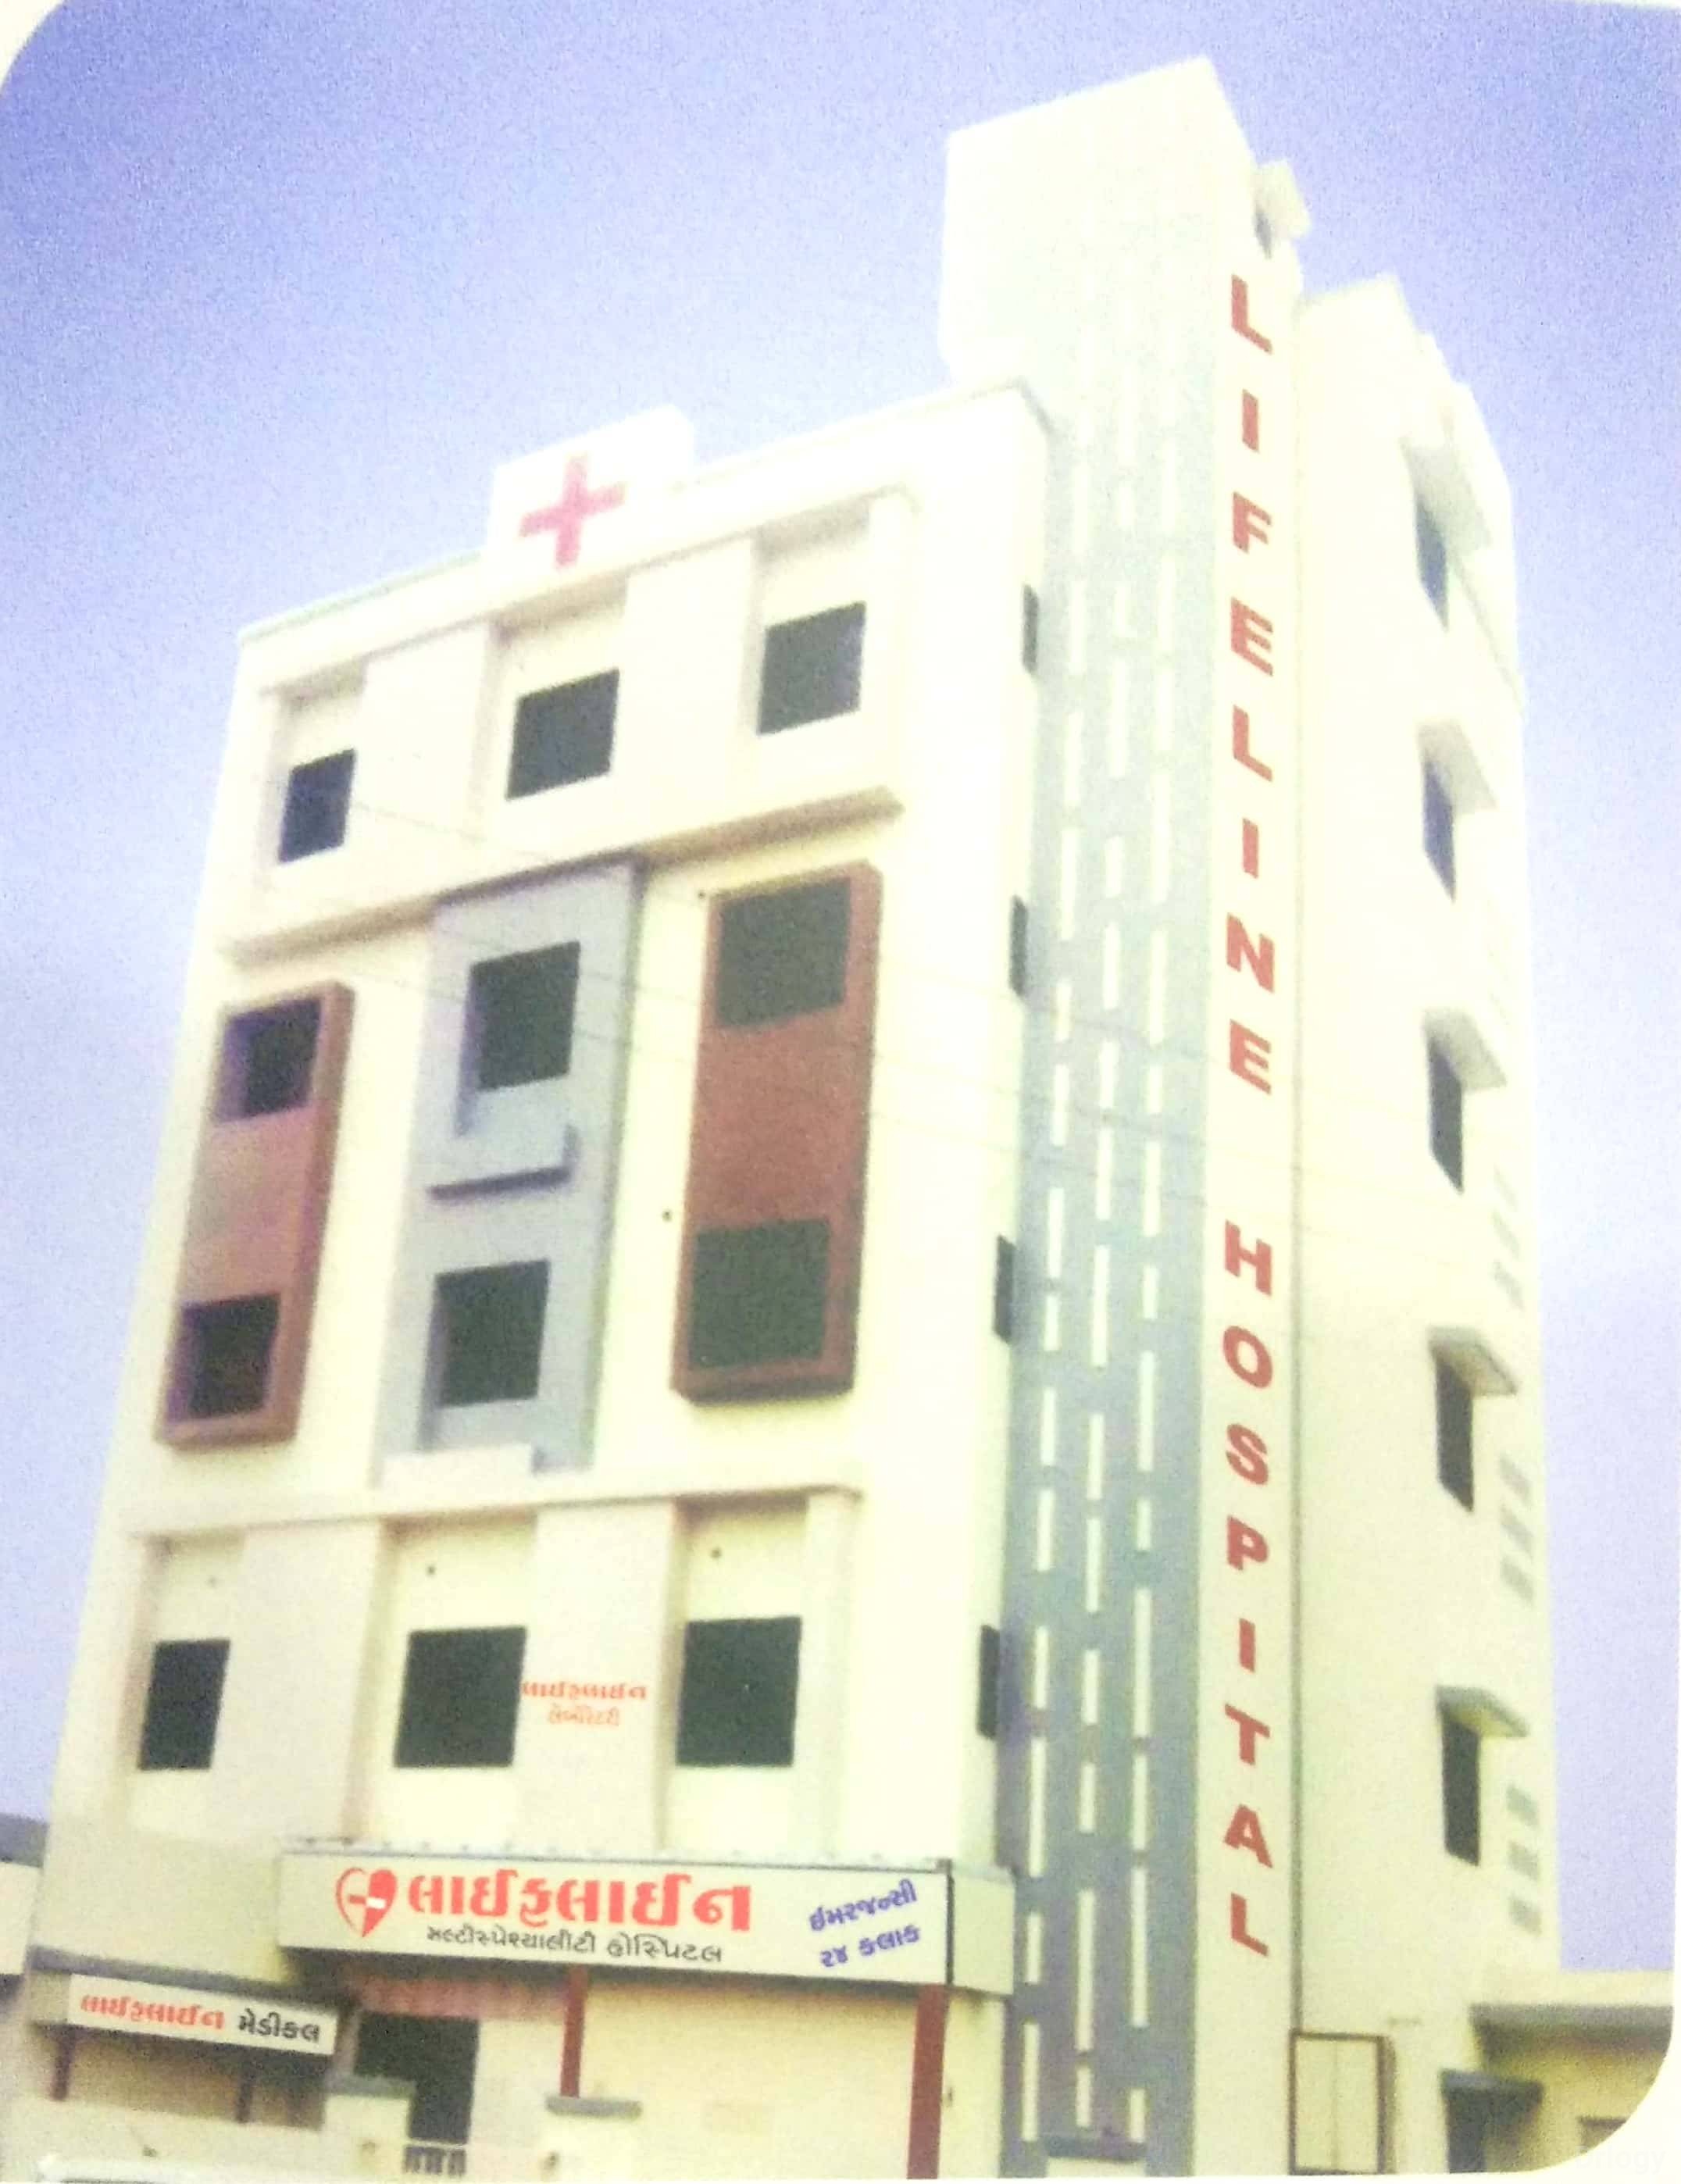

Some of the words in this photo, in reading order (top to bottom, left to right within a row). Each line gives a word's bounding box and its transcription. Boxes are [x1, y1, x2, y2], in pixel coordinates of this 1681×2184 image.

[1226, 273, 1275, 1095] LIFELINE
[1222, 1219, 1274, 1957] HOSPITAL
[408, 1868, 751, 1932] લાઈફલાઈન
[607, 1932, 722, 1962] હોસ્પિટલ
[819, 1944, 848, 1968] ૨૪
[858, 1924, 920, 1957] કલાક
[238, 2007, 320, 2043] મેડીકલ
